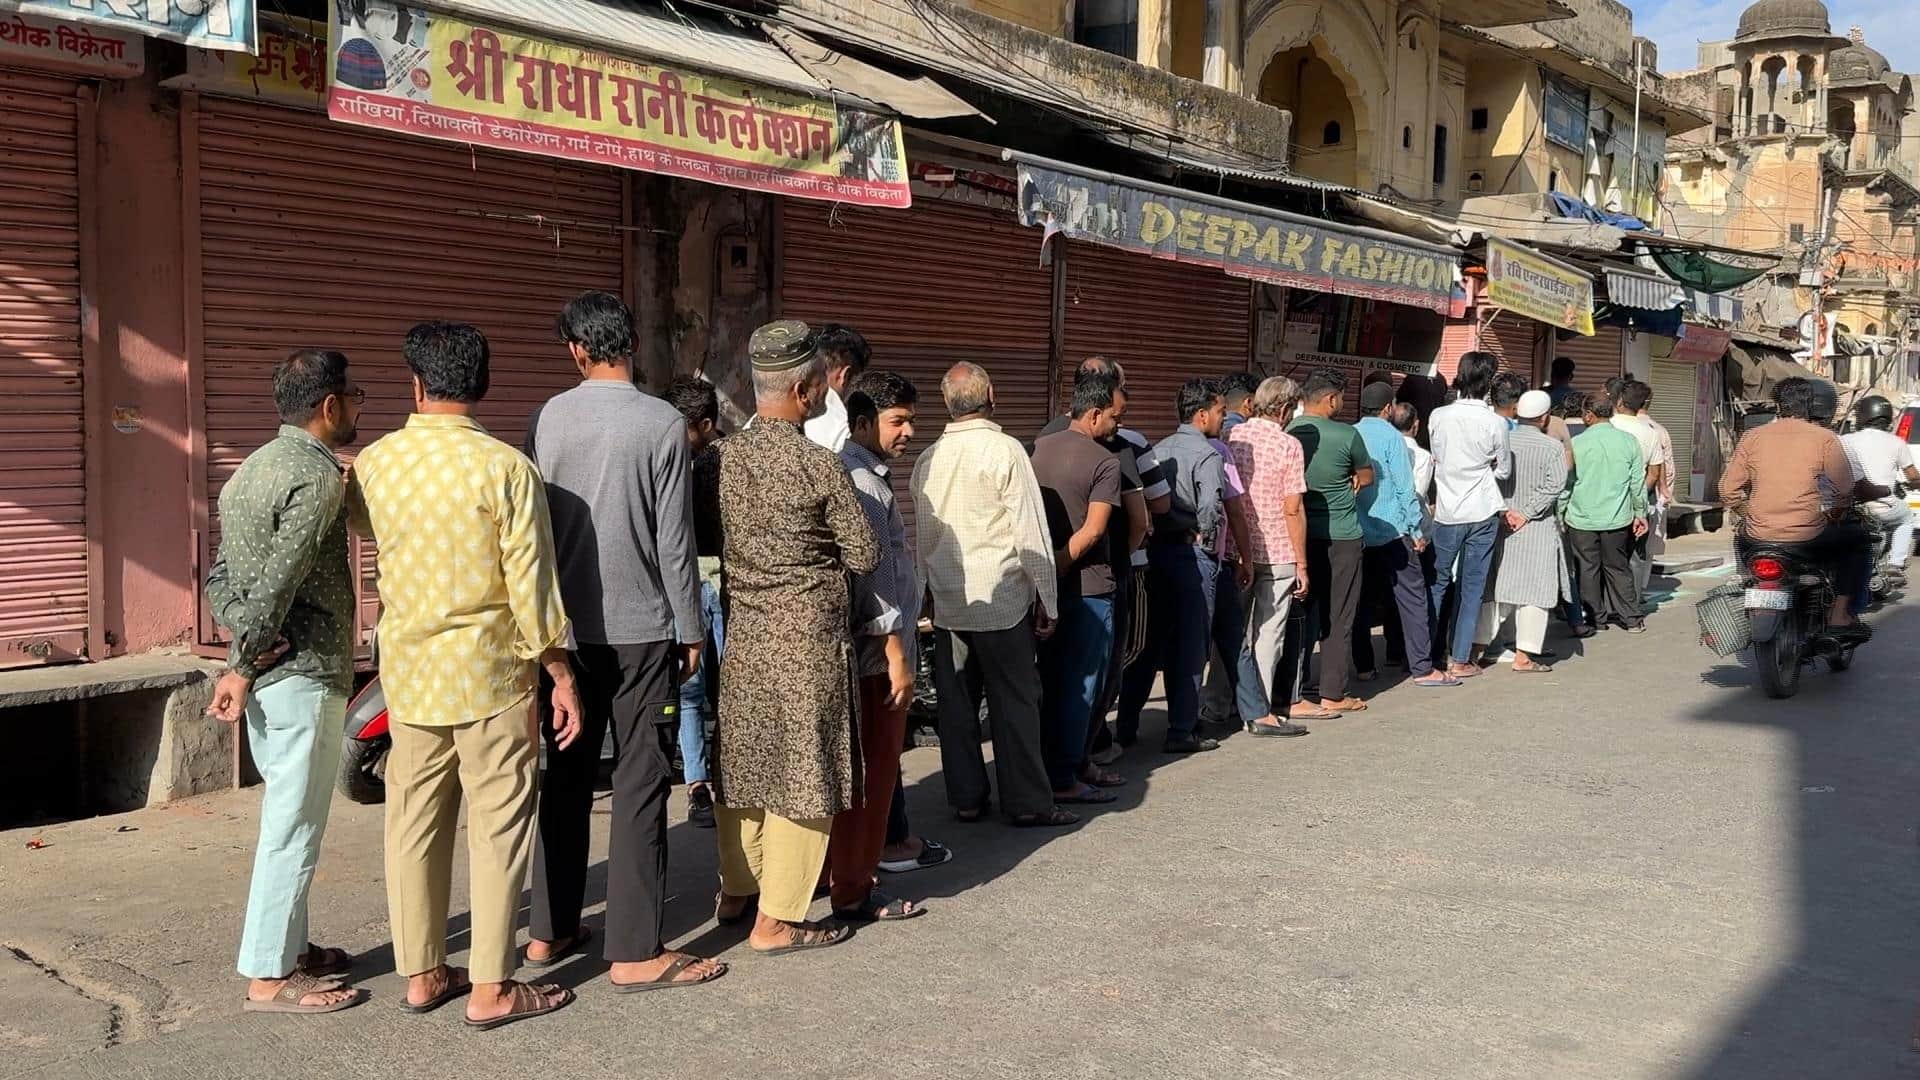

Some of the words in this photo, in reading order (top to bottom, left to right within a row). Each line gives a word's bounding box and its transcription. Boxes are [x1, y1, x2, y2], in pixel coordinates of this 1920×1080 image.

[0, 16, 51, 48] थोक
[55, 24, 126, 61] विक्रेता
[446, 27, 508, 105] श्री
[513, 54, 603, 121] राधा
[608, 71, 688, 138] रानी
[692, 89, 834, 164] कलेक्शन
[566, 135, 591, 153] गर्म
[627, 147, 656, 163] हाथ
[657, 149, 672, 166] के
[749, 168, 769, 186] एवं
[771, 169, 819, 191] पिचकारी
[820, 179, 834, 193] के
[838, 181, 862, 197] थोक
[865, 183, 904, 200] विक्रेता
[1141, 202, 1312, 272] DEEPAK
[1320, 236, 1454, 292] FASHION
[1505, 261, 1521, 280] रवि
[1295, 352, 1328, 364] DEEPAK
[1329, 354, 1364, 367] FASHION
[1377, 362, 1421, 373] COSMETIC
